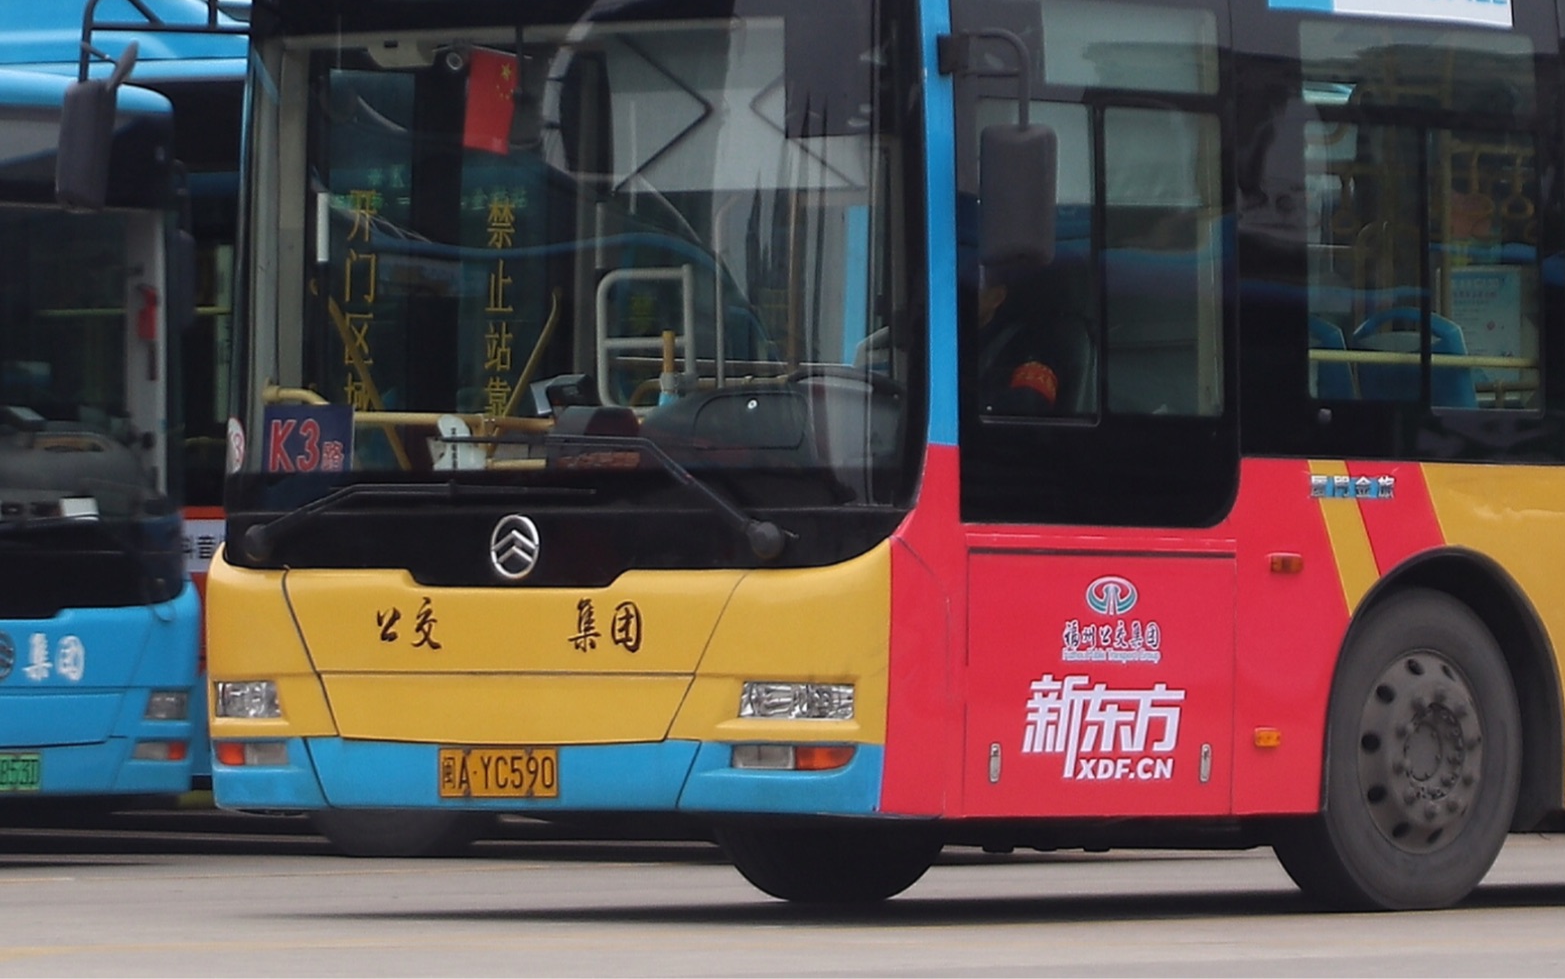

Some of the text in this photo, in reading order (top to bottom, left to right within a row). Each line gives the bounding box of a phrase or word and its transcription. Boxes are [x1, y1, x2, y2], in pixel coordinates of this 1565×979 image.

[269, 418, 344, 472] K3路
[376, 597, 643, 653] 公交 集团
[1062, 620, 1160, 650] 福州公交集团
[1022, 674, 1186, 779] 新东方
[1076, 757, 1174, 780] XDF.CN
